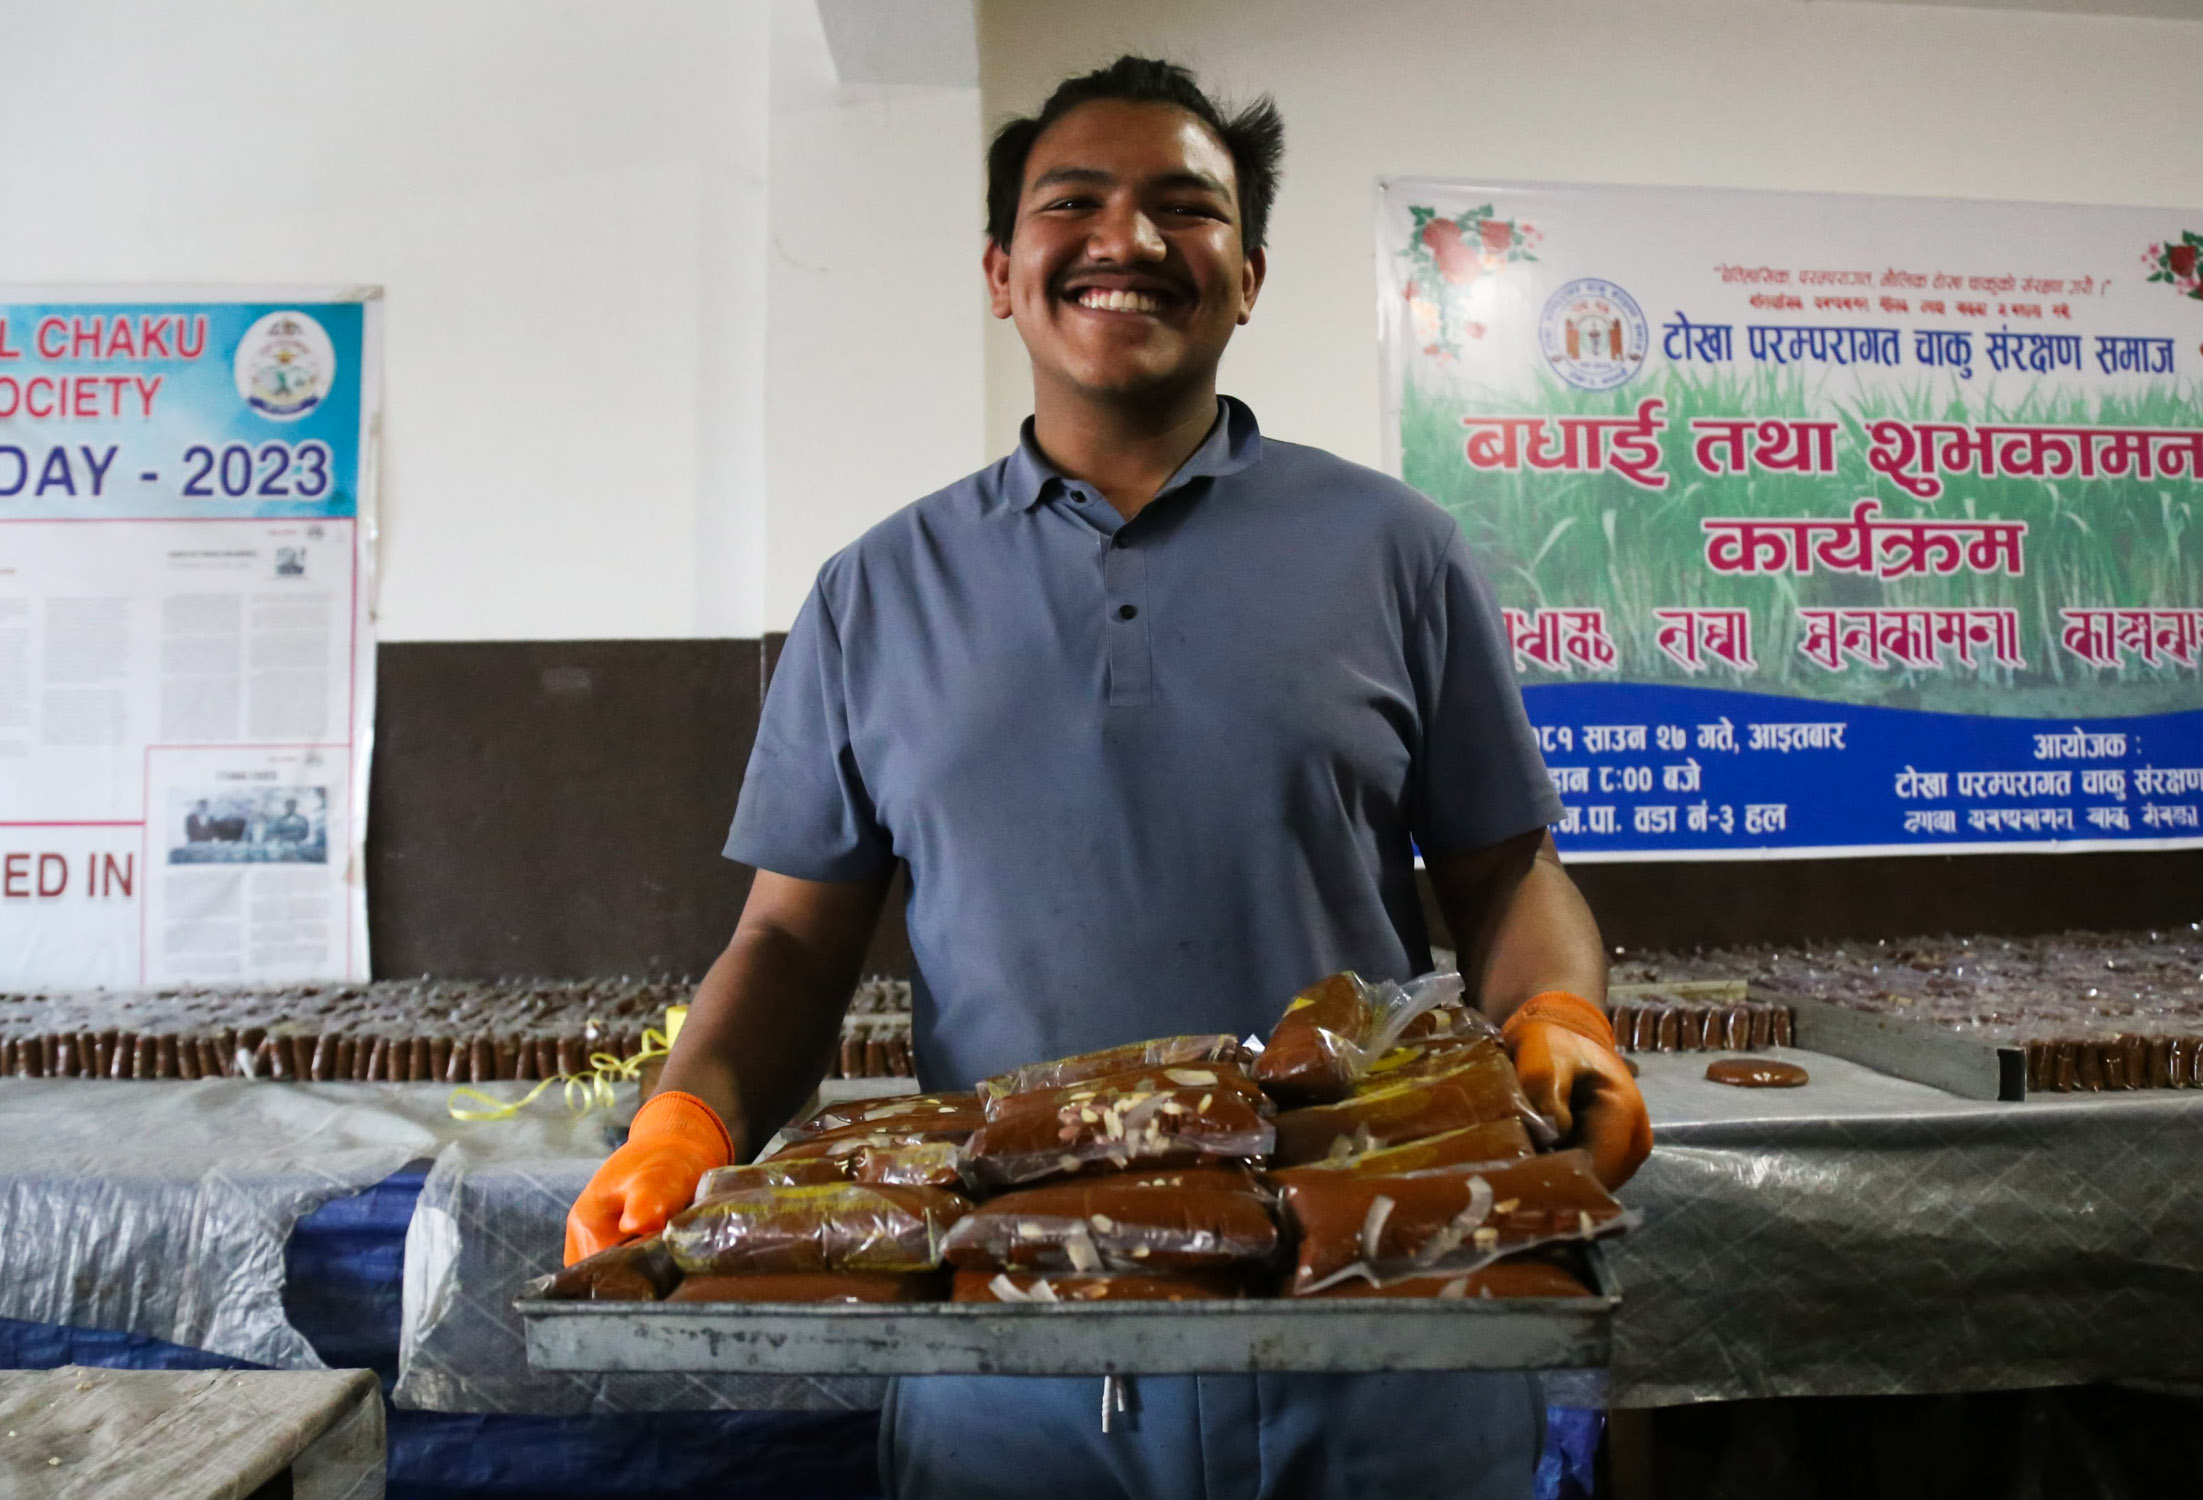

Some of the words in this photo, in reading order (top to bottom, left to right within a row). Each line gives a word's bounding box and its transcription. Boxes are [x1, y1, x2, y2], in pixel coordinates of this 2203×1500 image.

[0, 320, 20, 358] L
[39, 318, 205, 358] CHAKU
[1664, 311, 1733, 363] टोखा
[1749, 326, 1899, 365] परम्परागत
[1915, 330, 1974, 379] चाकु
[1986, 325, 2083, 374] संरक्षण
[2095, 337, 2175, 374] समाज
[0, 377, 161, 418] OCIETY
[1464, 399, 1666, 486] बधाई
[1694, 421, 1837, 472] तथा
[0, 446, 117, 496] DAY
[183, 446, 328, 496] 2023
[1706, 501, 2024, 577] कार्यक्रम
[1583, 726, 1647, 752] साउन
[1657, 724, 1687, 751] २७
[1698, 717, 1739, 753] गते,
[1749, 723, 1846, 752] आइतबार
[2034, 727, 2126, 759] आयोजक
[1664, 758, 1701, 791] बजे
[1896, 766, 1948, 798] टोखा
[1958, 771, 2071, 797] परम्परागत
[2082, 770, 2126, 800] चाकु
[1635, 806, 1677, 832] वडा
[1745, 804, 1787, 833] हल
[6, 854, 66, 896] ED
[90, 855, 132, 896] IN
